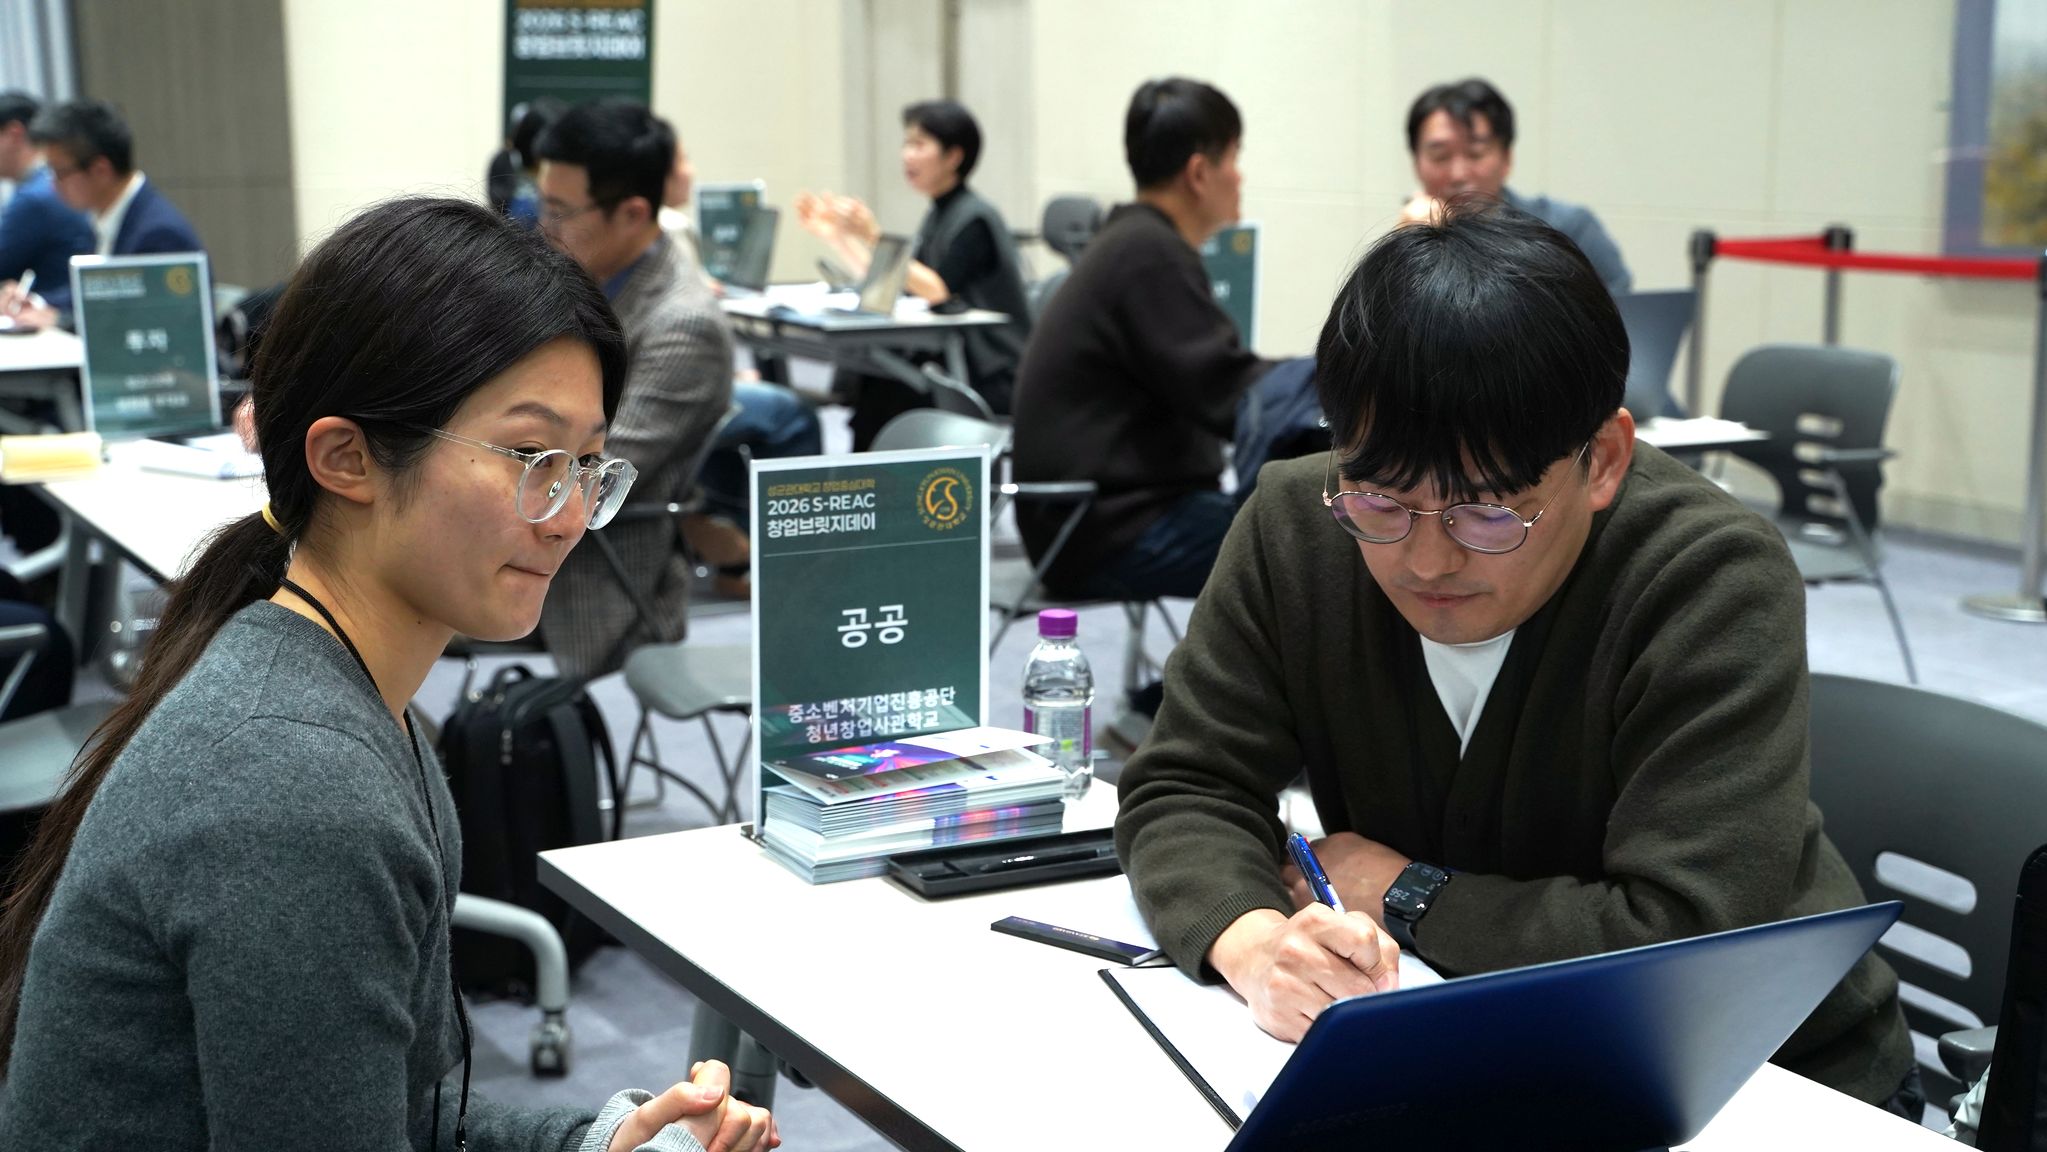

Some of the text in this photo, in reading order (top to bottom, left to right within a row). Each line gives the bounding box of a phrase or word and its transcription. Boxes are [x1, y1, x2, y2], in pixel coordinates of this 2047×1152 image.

[767, 493, 876, 516] 2026 S-REAC
[767, 512, 876, 538] 창업브릿지데이
[837, 604, 909, 648] 공공
[788, 686, 956, 724] 중소벤처기업진흥공단
[805, 710, 940, 744] 청년창업사관학교
